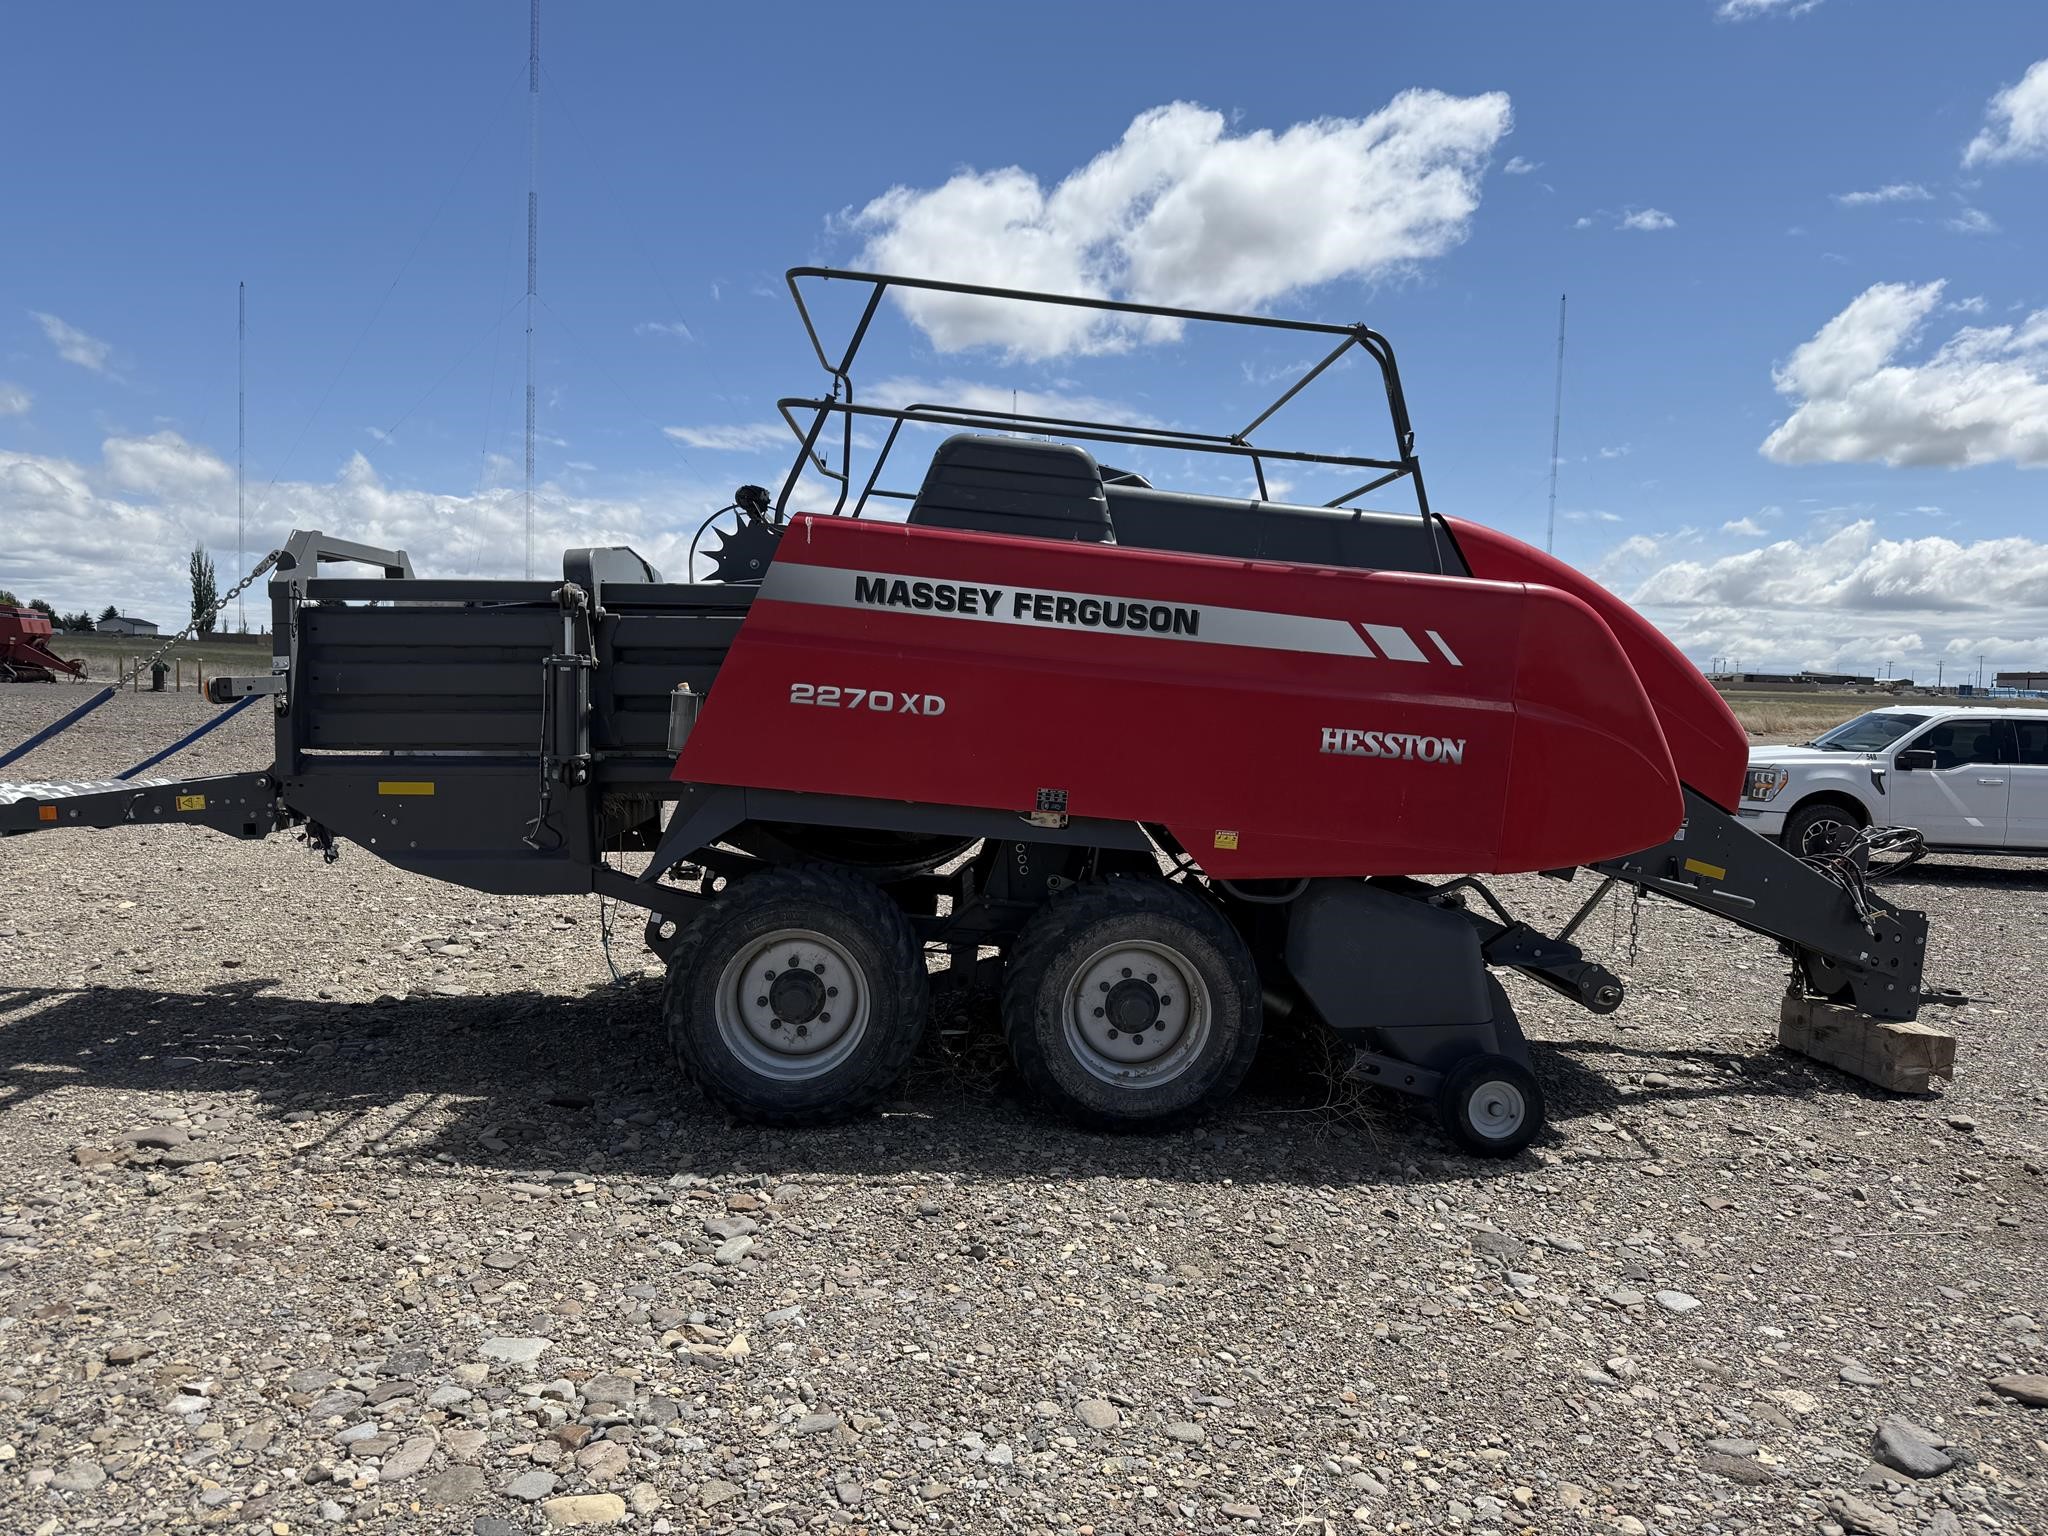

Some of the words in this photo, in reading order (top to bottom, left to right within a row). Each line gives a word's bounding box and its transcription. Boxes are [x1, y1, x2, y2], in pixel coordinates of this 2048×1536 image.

[854, 575, 1003, 617] MASSEY
[1013, 591, 1201, 636] FERGUSON
[1319, 727, 1467, 765] HESSTON
